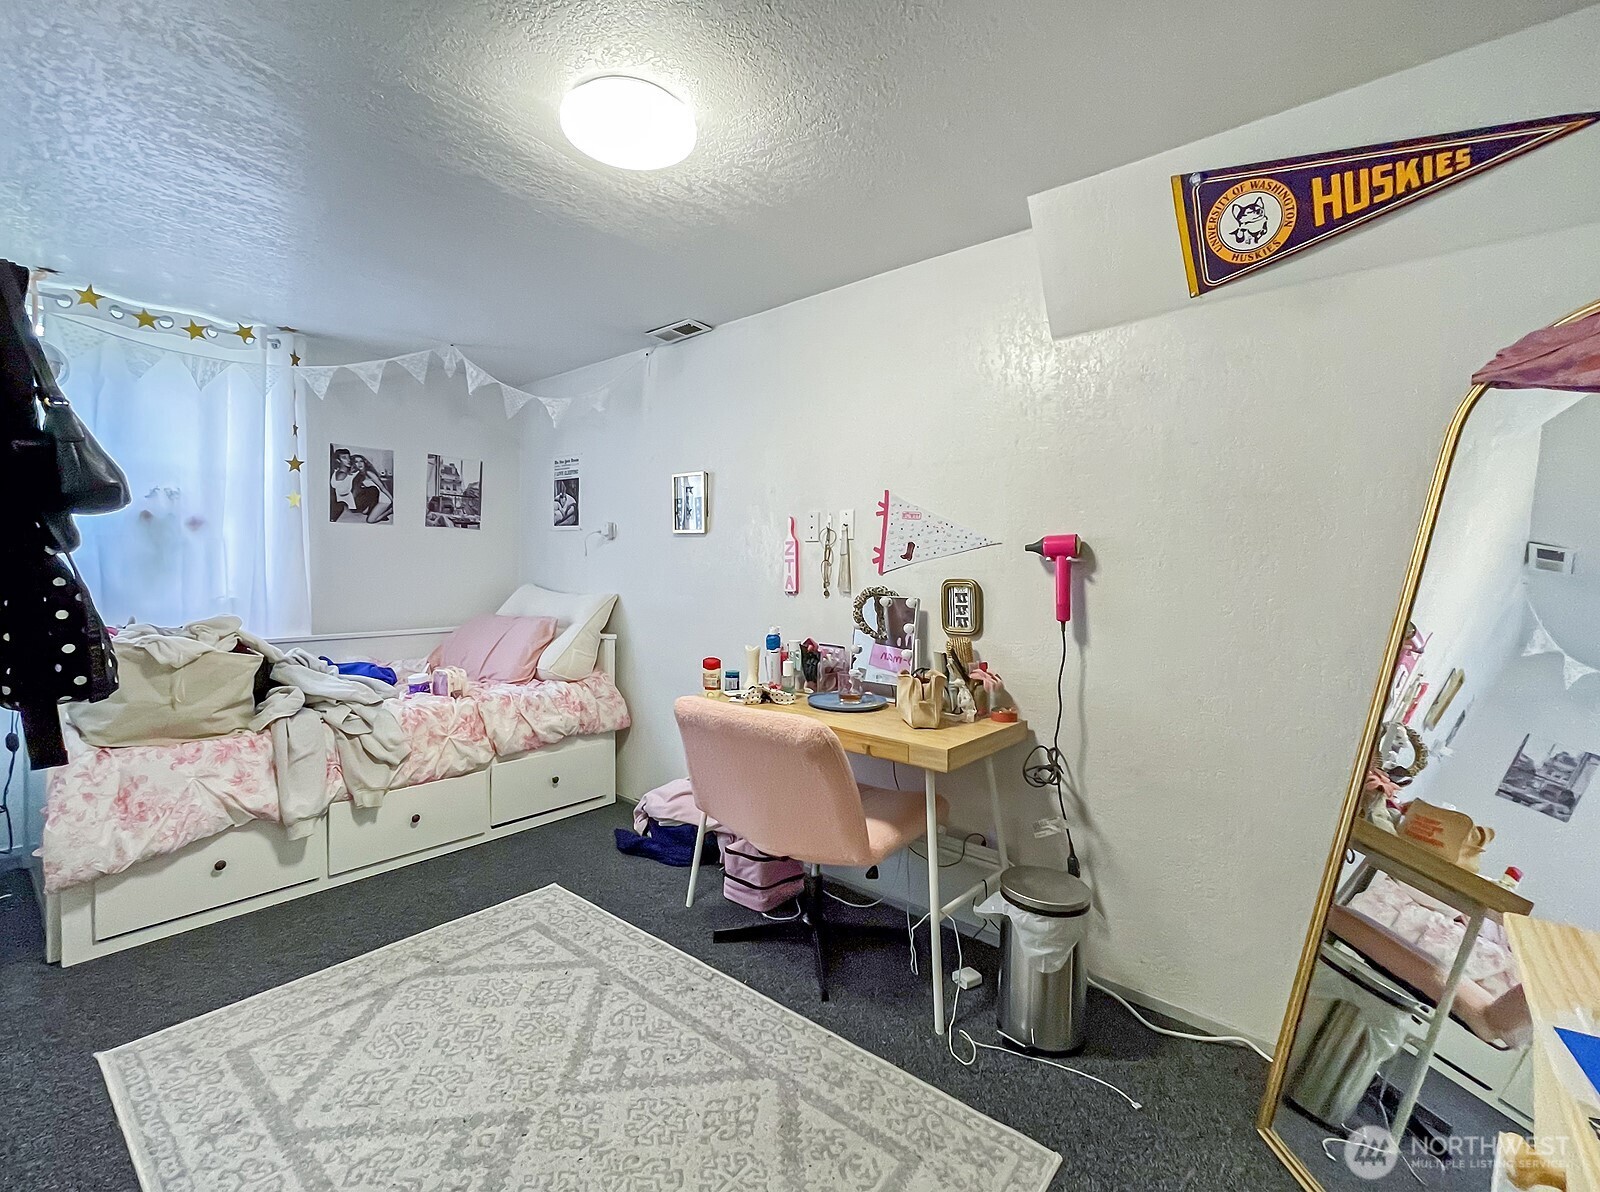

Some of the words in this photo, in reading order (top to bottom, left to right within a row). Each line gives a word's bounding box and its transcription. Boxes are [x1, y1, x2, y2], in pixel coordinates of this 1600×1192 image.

[1208, 194, 1230, 253] UNIVERSITY
[1232, 184, 1246, 196] OF
[1250, 180, 1296, 228] WASHINGTON
[1312, 147, 1471, 227] HUSKIES
[1231, 239, 1282, 262] HUSKIES
[785, 541, 795, 590] ZTA
